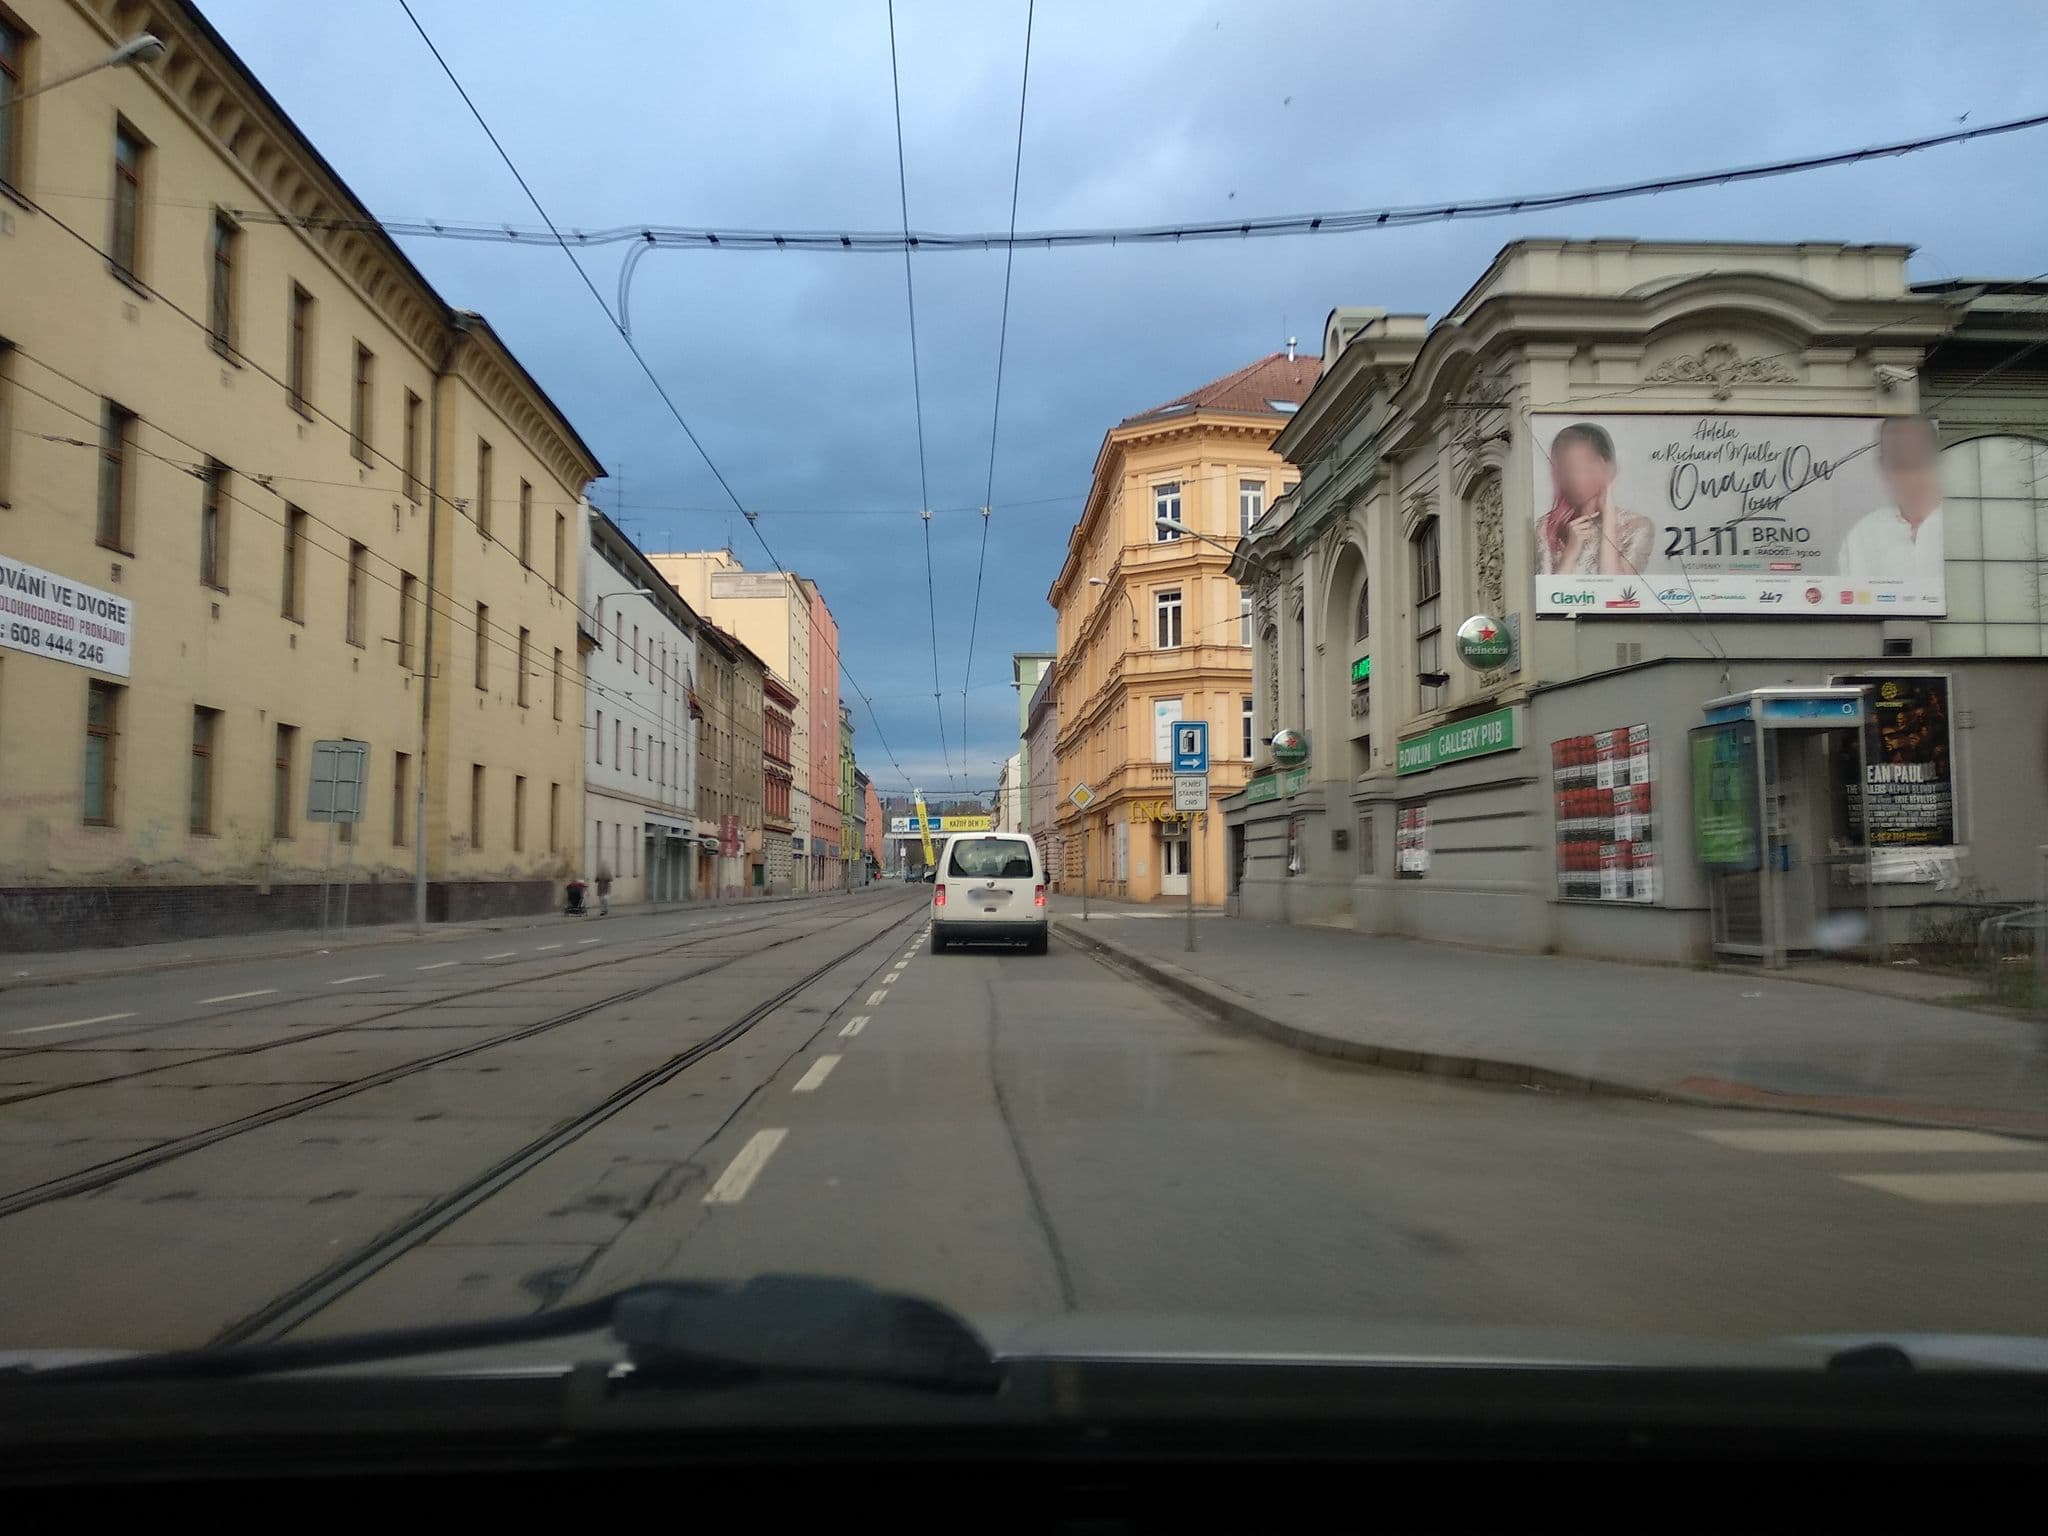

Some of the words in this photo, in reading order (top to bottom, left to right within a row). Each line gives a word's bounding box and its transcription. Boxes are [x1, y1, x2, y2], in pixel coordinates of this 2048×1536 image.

[1666, 442, 1723, 463] Richard
[1726, 441, 1783, 466] Müller
[1670, 462, 1745, 511] Ona
[1664, 526, 1750, 556] 21.11.
[1752, 527, 1810, 543] BRNO
[52, 583, 72, 607] VE
[77, 592, 126, 624] DVOŘE
[1551, 591, 1595, 604] Clavin
[10, 623, 40, 647] 608
[45, 633, 73, 655] 444
[78, 641, 104, 664] 246
[80, 620, 126, 646] PRONÁJMU
[1464, 646, 1508, 655] Heineken
[1400, 743, 1431, 768] BOWLIN
[1439, 726, 1480, 756] GALLERY
[1481, 720, 1503, 746] PUB
[1867, 765, 1891, 783] EAN
[1894, 765, 1924, 783] PAUL
